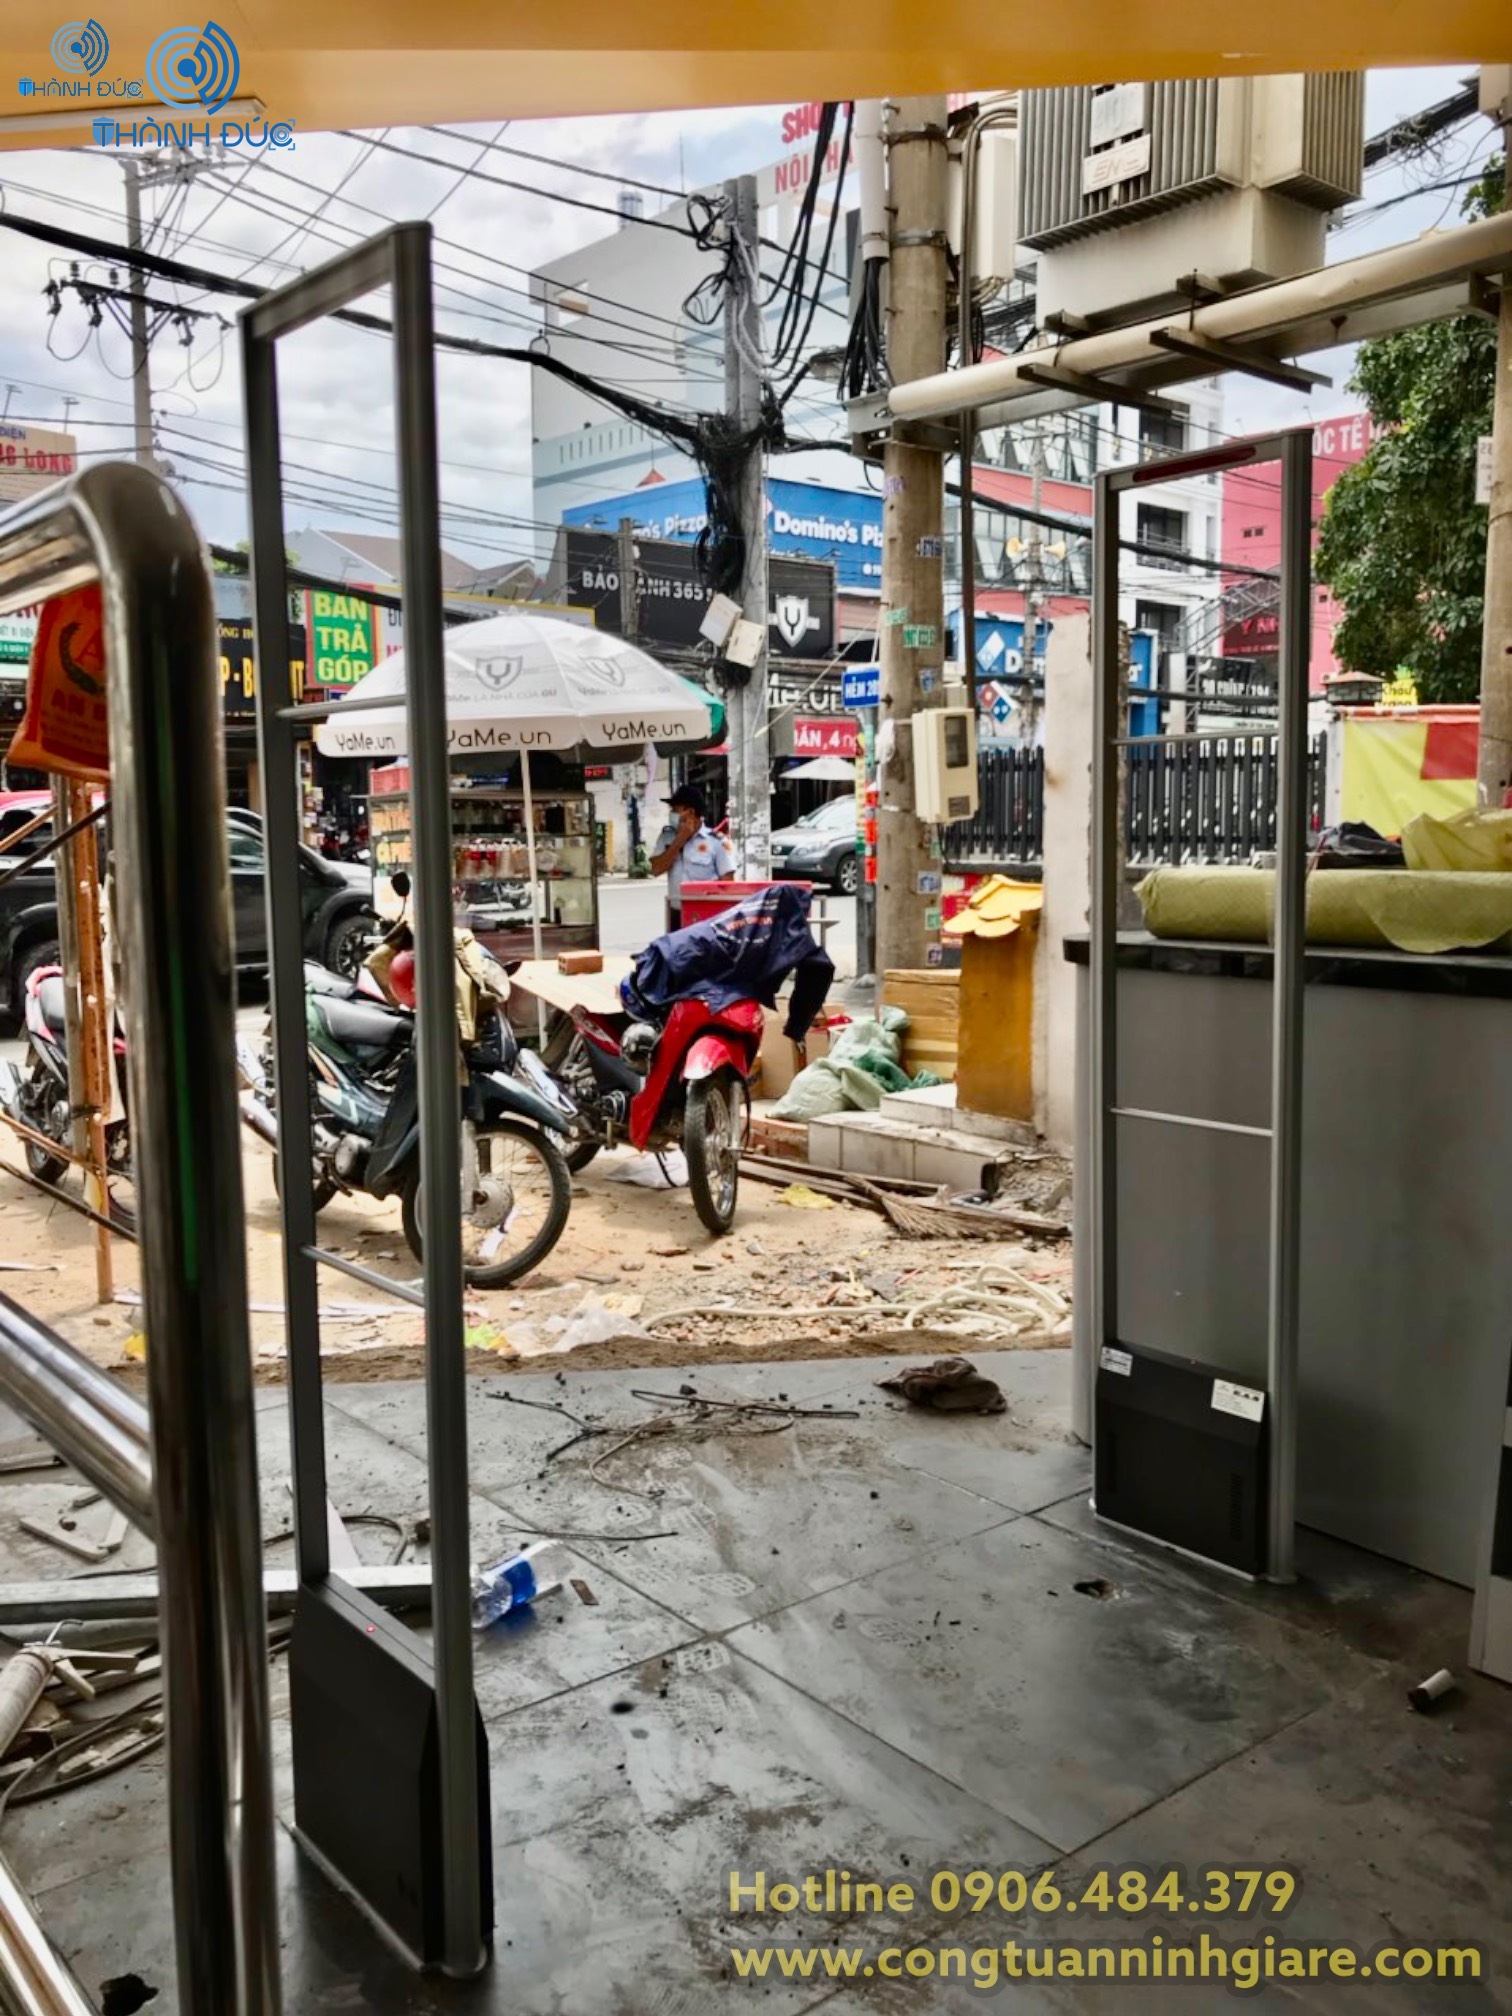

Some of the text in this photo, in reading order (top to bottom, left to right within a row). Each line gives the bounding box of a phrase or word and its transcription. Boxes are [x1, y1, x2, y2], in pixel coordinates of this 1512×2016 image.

[774, 510, 858, 544] Domino's
[582, 564, 619, 591] BẢO
[673, 581, 704, 601] 365
[316, 623, 369, 653] TRẢ
[318, 654, 370, 683] GÓP
